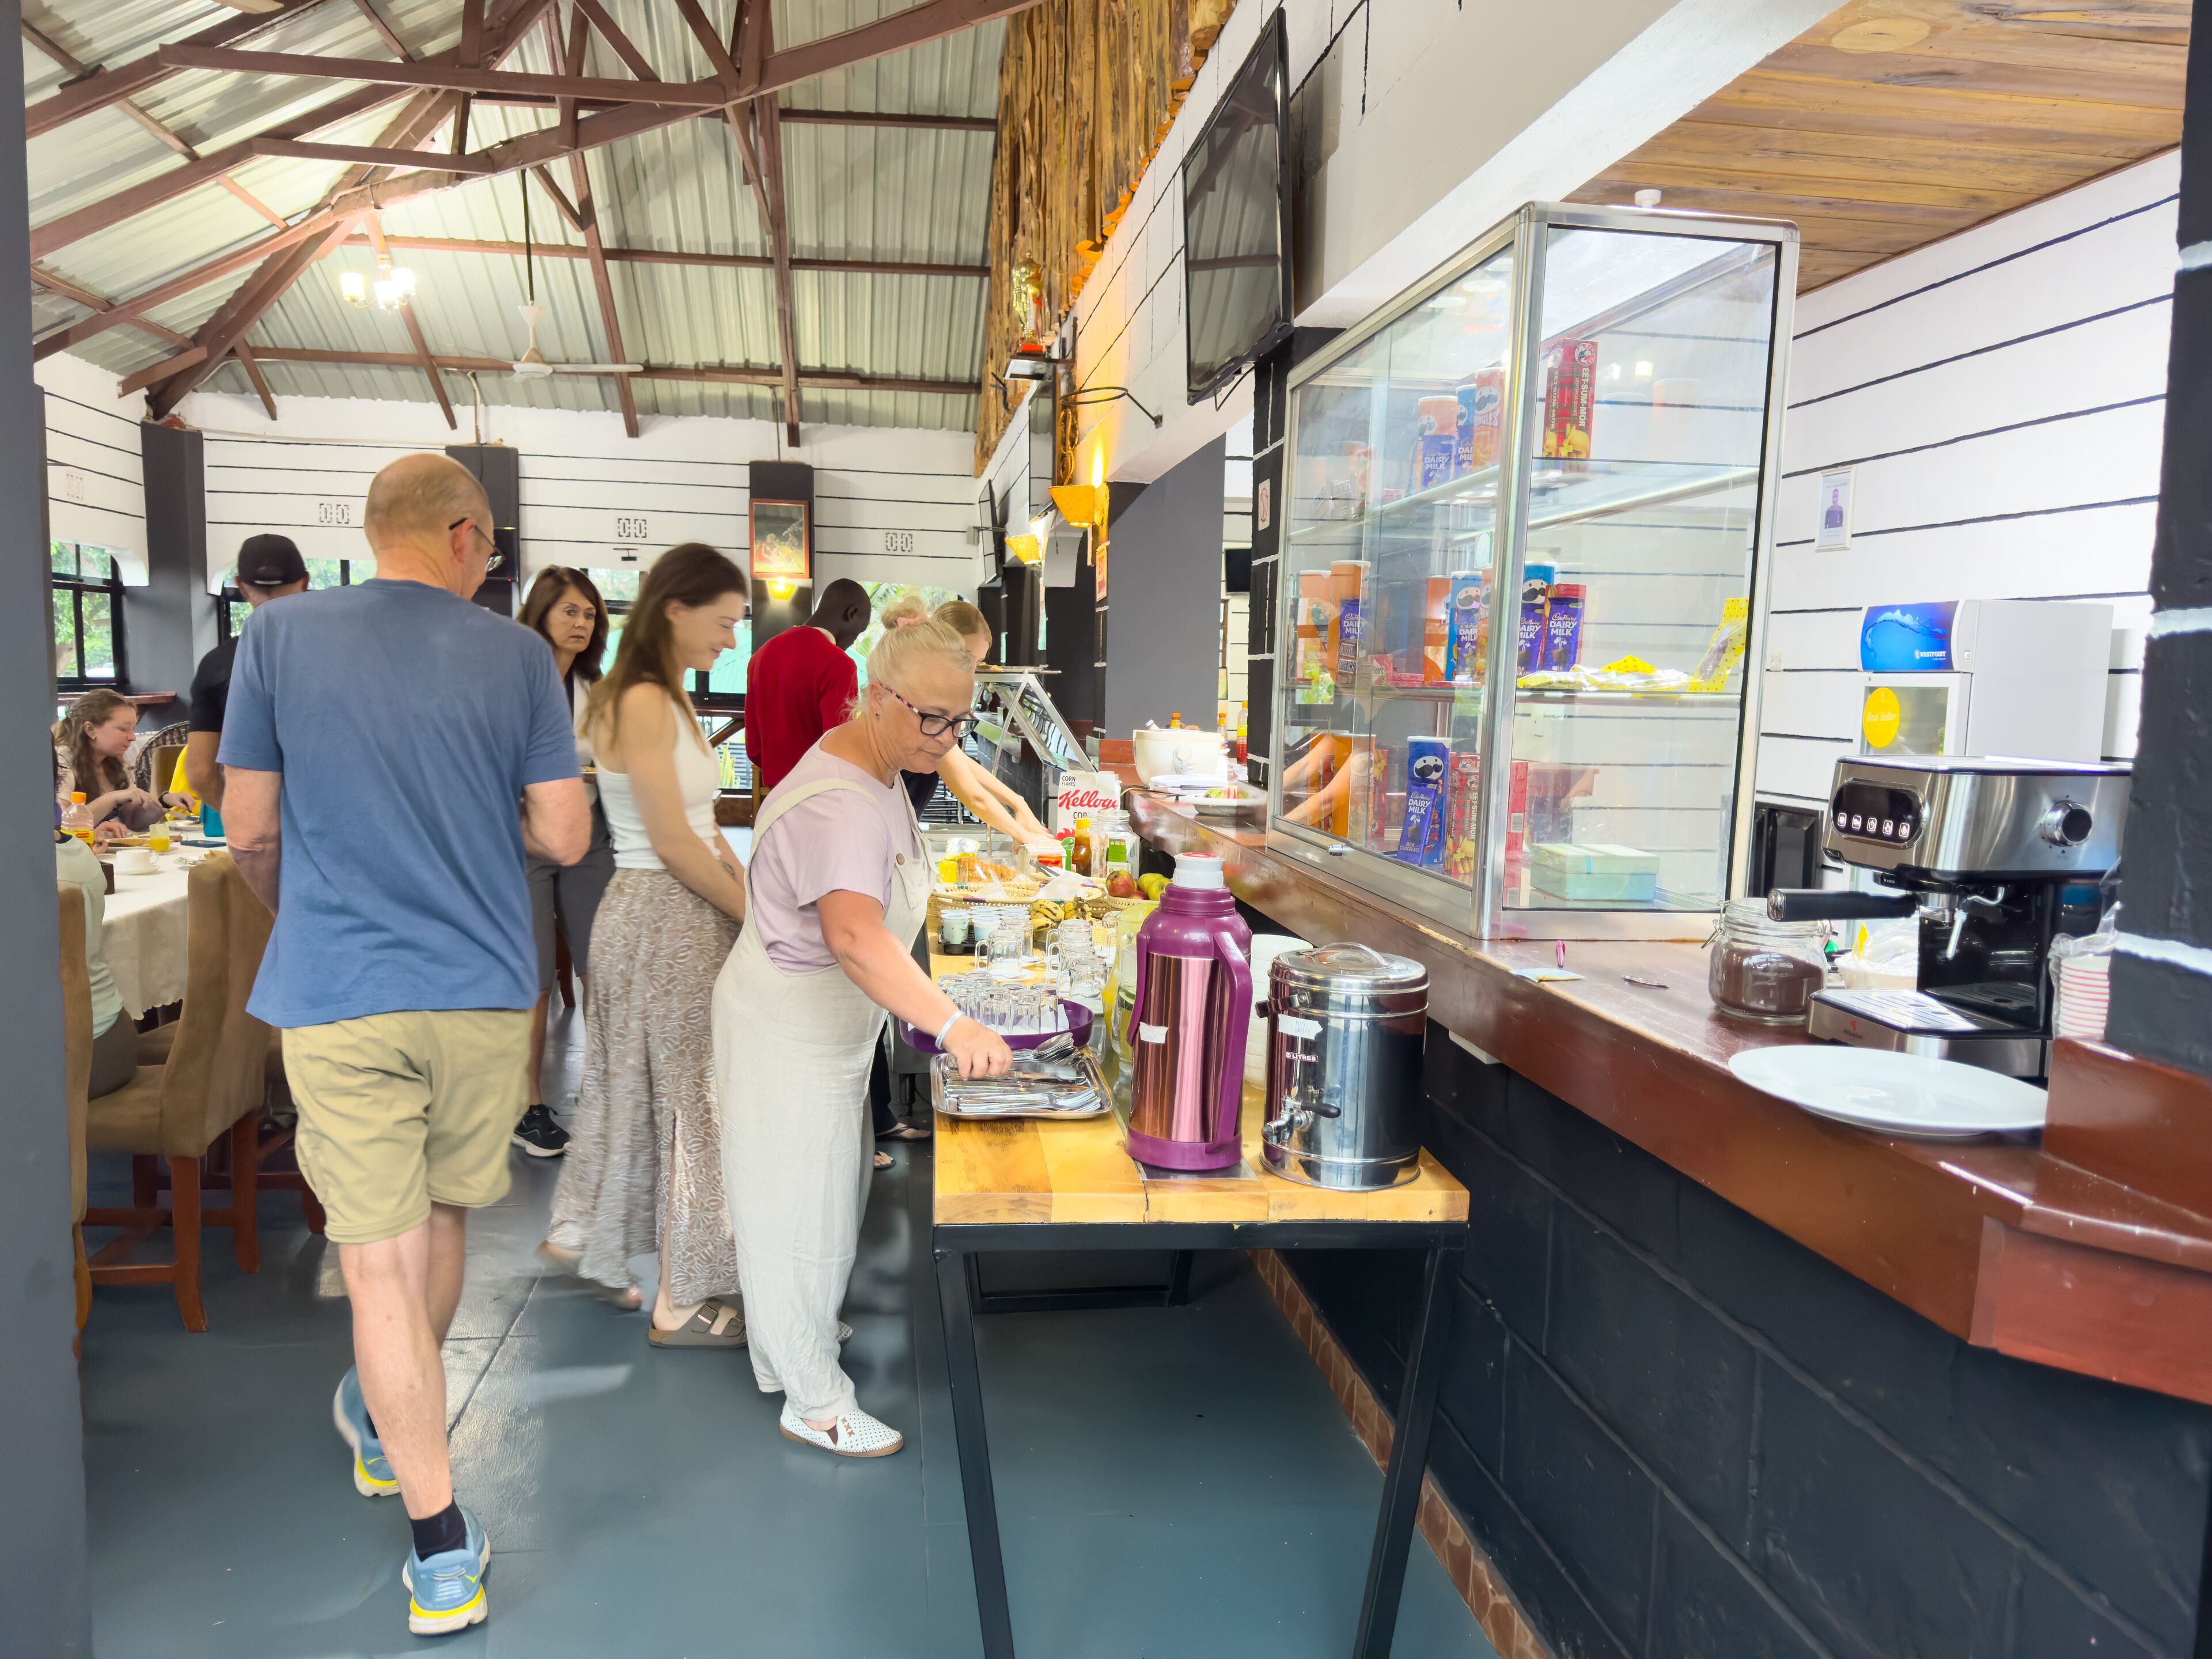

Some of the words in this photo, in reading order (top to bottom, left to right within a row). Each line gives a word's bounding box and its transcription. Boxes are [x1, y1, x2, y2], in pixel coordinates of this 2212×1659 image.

[1578, 368, 1589, 427] EET-SUM-MOR
[1425, 456, 1450, 464] DAIRY
[1459, 453, 1472, 461] MIL
[1552, 612, 1577, 622] Cadbury
[1550, 620, 1578, 629] DAIRY
[1411, 791, 1431, 801] Cadbury
[1408, 798, 1431, 808] DAIRY
[1408, 805, 1426, 815] MILK
[1469, 792, 1478, 839] EET-SUM-MOR
[1400, 845, 1420, 853] CHOCOLATE
[1292, 1053, 1316, 1061] LITRES
